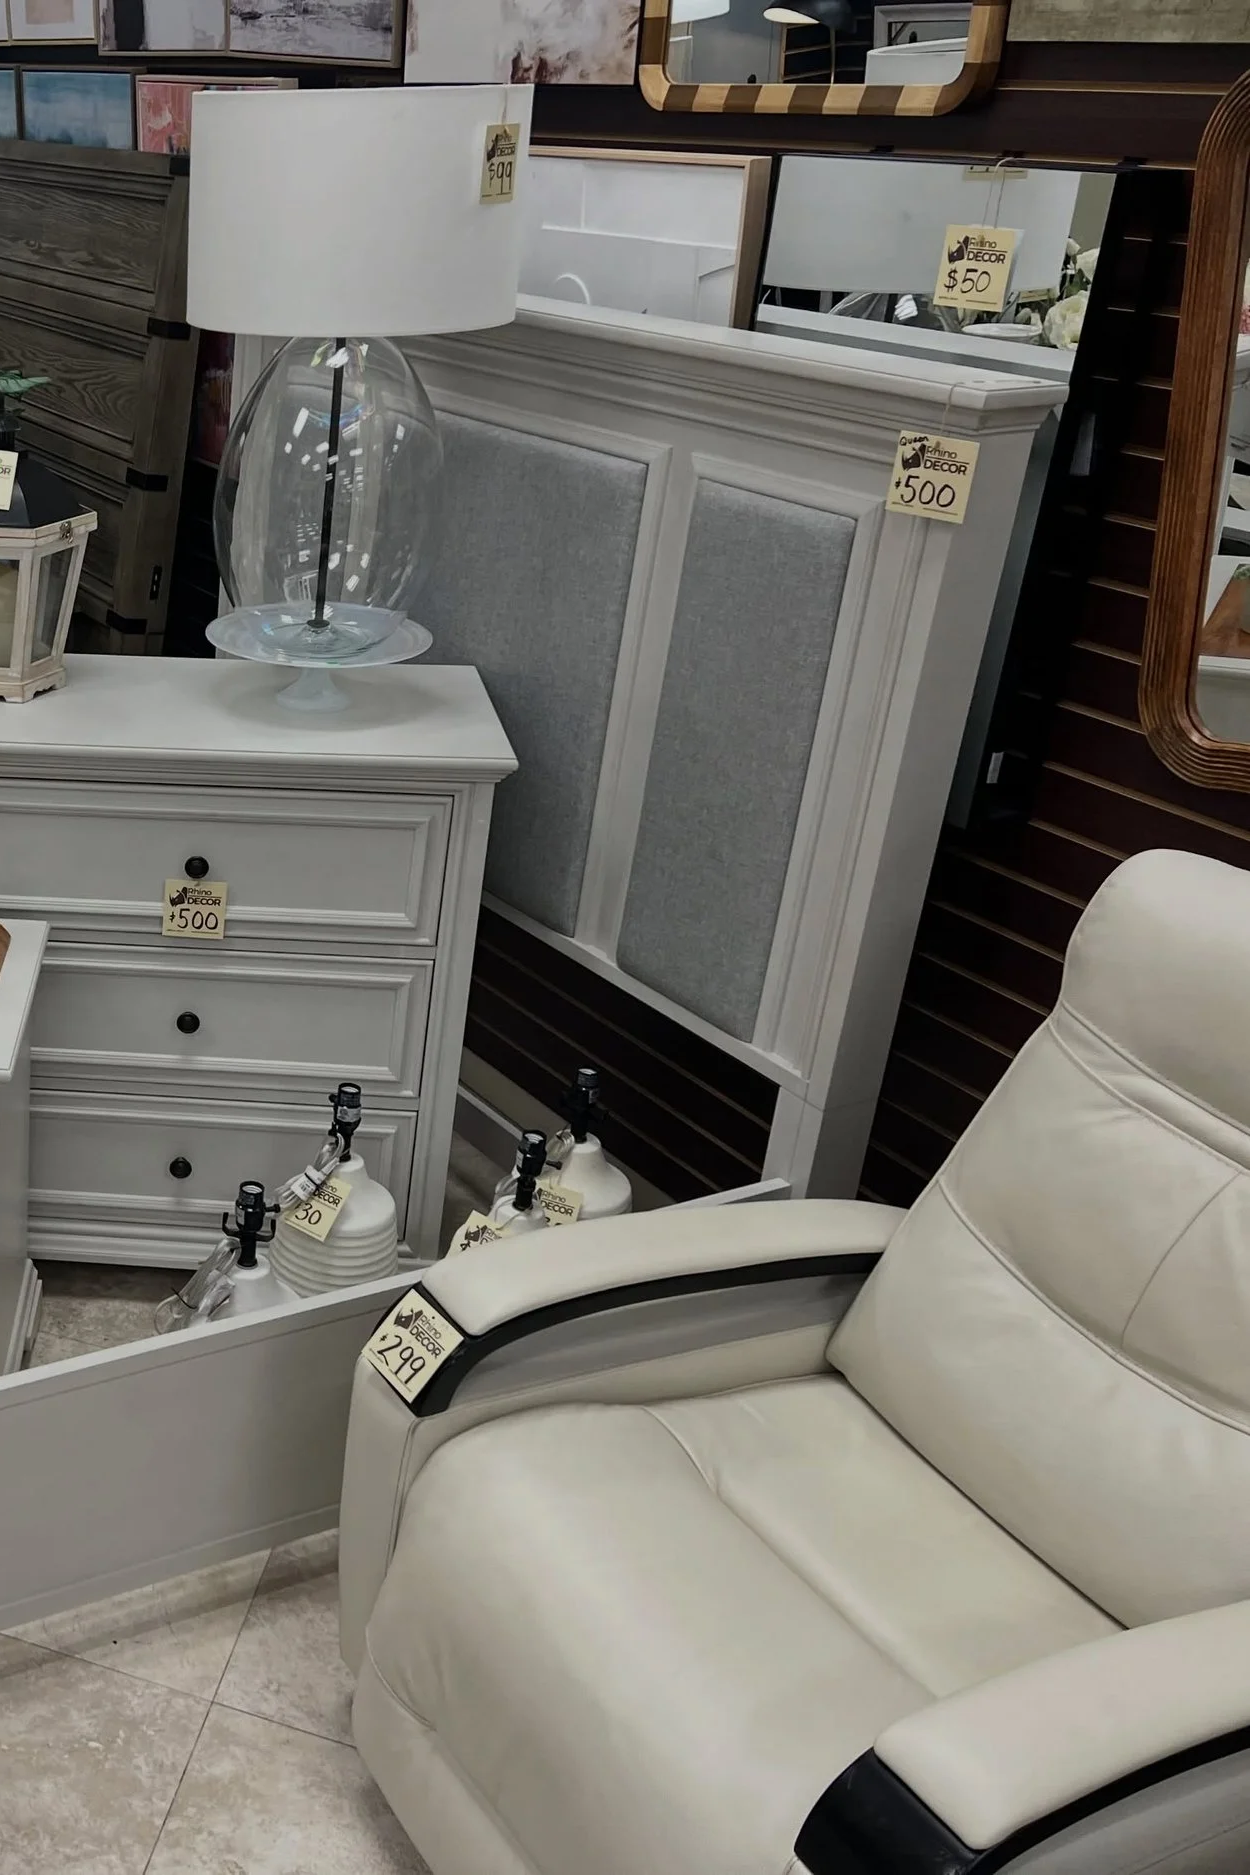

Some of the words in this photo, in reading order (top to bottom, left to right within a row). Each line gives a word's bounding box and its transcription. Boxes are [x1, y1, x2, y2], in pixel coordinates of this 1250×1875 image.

[488, 161, 513, 195] $99
[966, 251, 1006, 264] DECOR
[944, 267, 992, 293] $50
[899, 436, 929, 446] Queen
[926, 445, 958, 460] Rhino
[924, 459, 968, 475] DECOR
[894, 475, 956, 508] $500
[188, 887, 212, 896] Rhino
[187, 896, 221, 906] DECOR
[169, 908, 218, 930] $500
[314, 1190, 341, 1207] DECOR
[542, 1189, 567, 1204] Rhino
[540, 1200, 574, 1216] DECOR
[419, 1314, 442, 1340] Rhino
[409, 1324, 442, 1359] DECOR
[377, 1334, 426, 1384] $299
